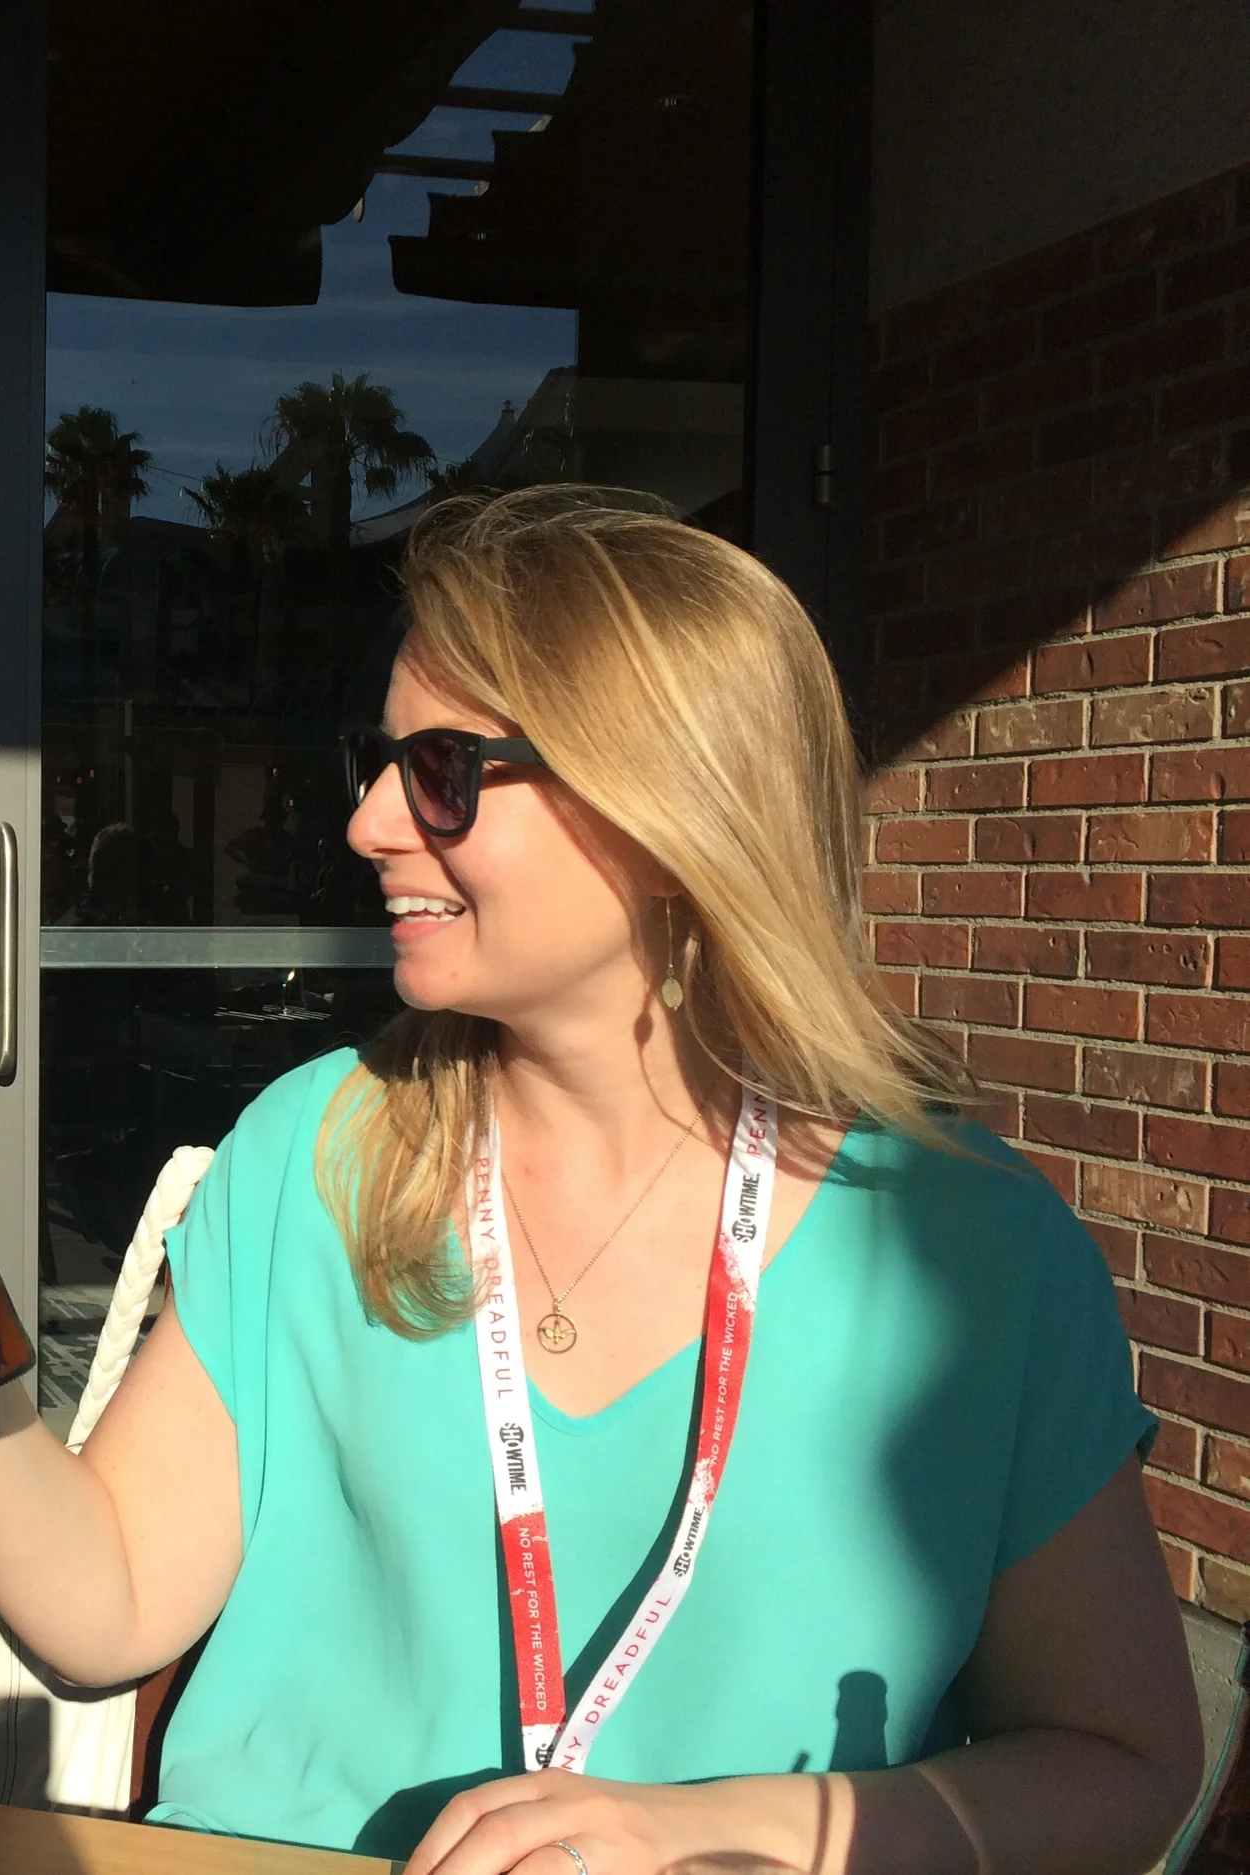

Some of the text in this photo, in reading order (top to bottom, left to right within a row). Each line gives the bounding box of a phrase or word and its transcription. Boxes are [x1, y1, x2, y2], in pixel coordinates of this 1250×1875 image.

[732, 1172, 760, 1243] SHOWTIME
[475, 1157, 513, 1399] PENNY DREADFUL
[710, 1292, 738, 1466] NO REST FOR THE WICKED
[499, 1422, 527, 1494] SHOWTIME
[674, 1505, 705, 1578] SHOWTIME
[518, 1527, 547, 1711] NO REST FOR THE WICKED
[585, 1595, 672, 1724] DREADFUL
